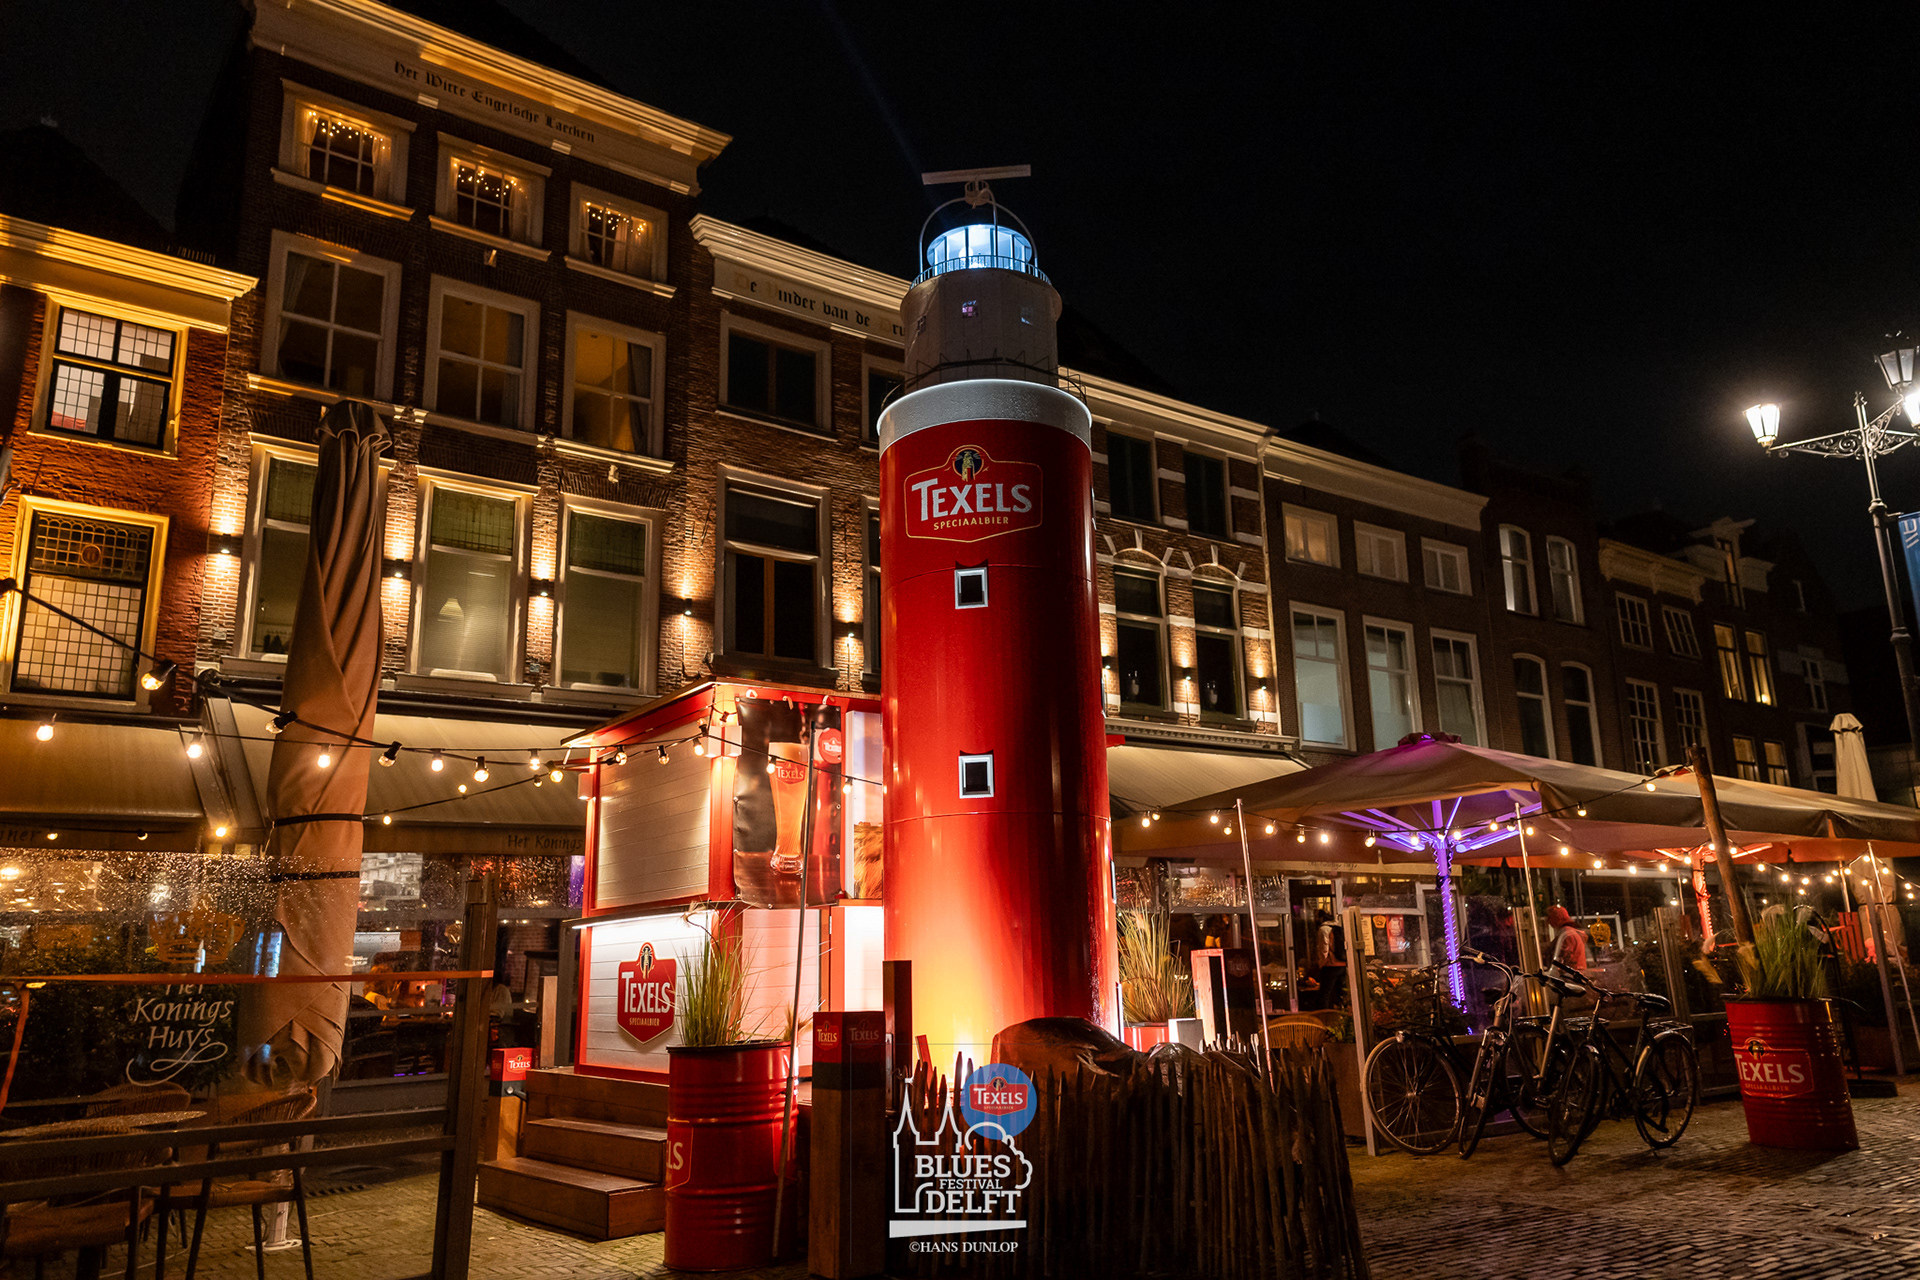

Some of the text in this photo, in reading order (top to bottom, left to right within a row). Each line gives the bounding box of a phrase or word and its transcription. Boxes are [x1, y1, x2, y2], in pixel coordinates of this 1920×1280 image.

[823, 301, 848, 321] van
[855, 310, 871, 326] de
[911, 477, 1033, 522] TEXELS
[933, 516, 1009, 531] SPECIAALBIER
[775, 765, 804, 780] TEXELS
[507, 834, 584, 853] Het Konings
[621, 971, 671, 1014] TEXELS
[133, 997, 235, 1027] Konings
[816, 1028, 838, 1042] TEXELS
[848, 1027, 880, 1041] TEXELS
[508, 1060, 531, 1069] TEXELS
[1734, 1053, 1805, 1084] TEXELS
